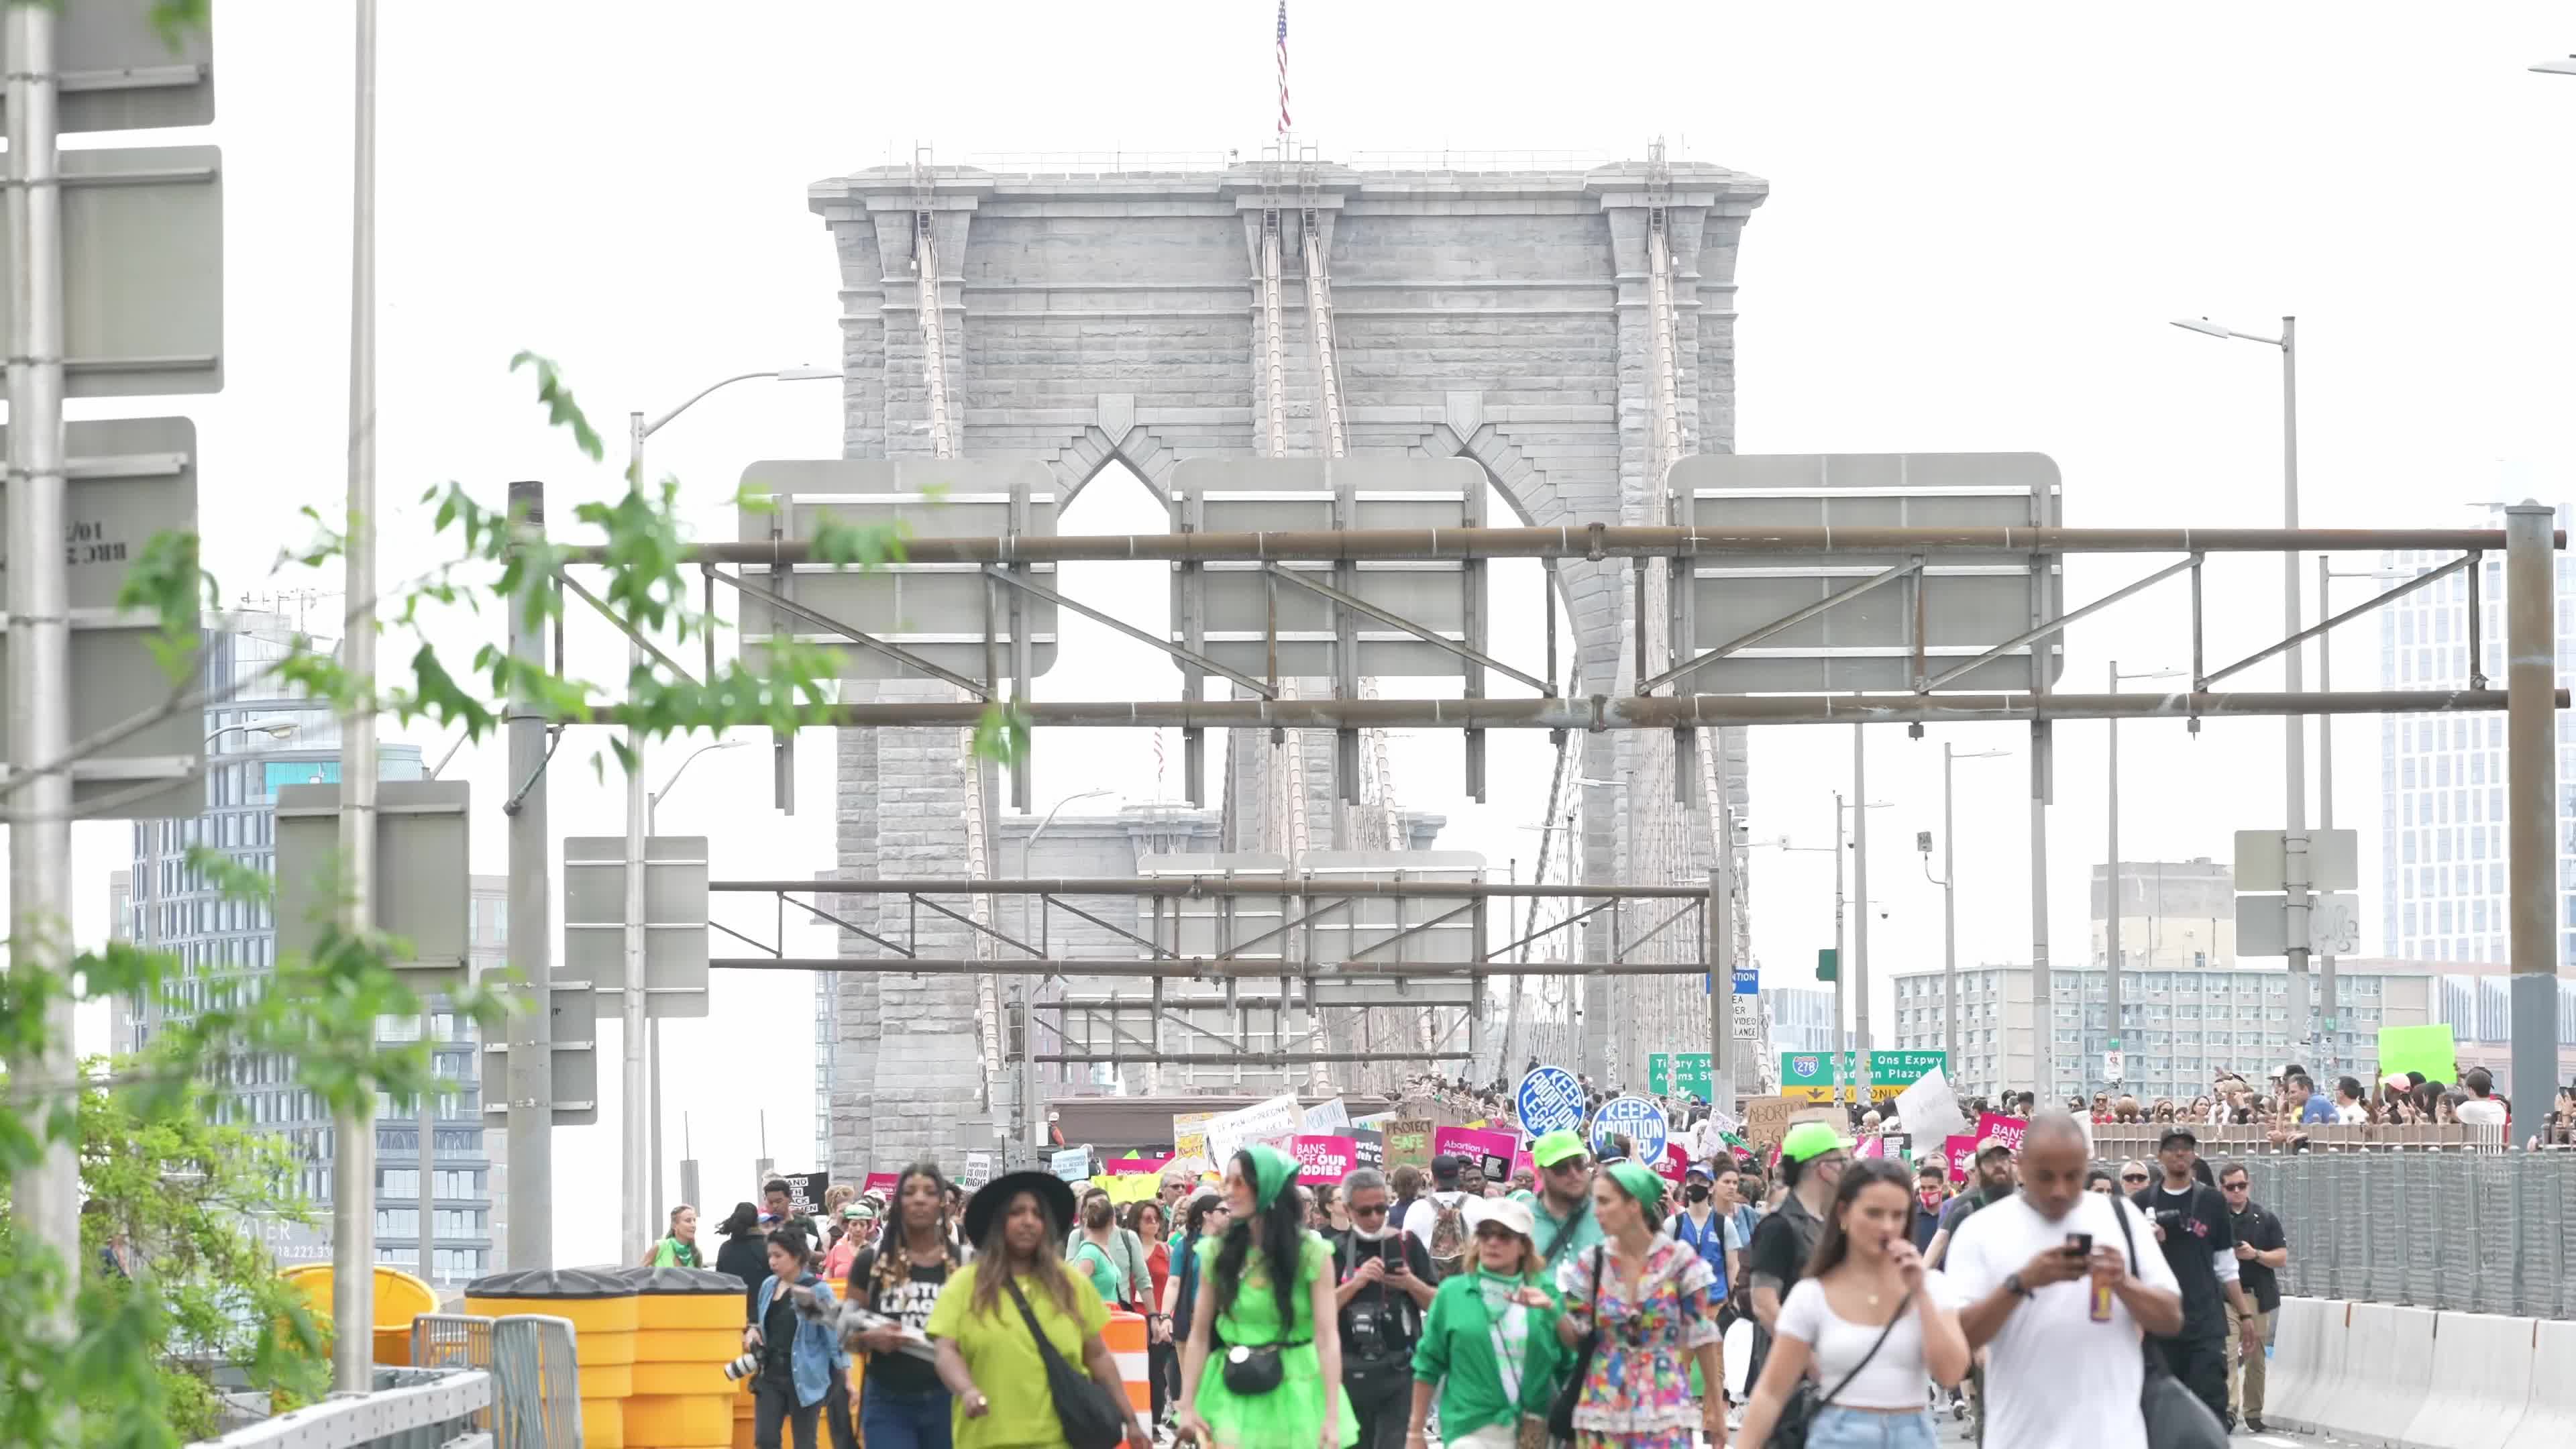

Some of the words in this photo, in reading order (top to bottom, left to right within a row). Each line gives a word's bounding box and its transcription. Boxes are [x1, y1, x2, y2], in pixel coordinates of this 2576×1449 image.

[1734, 1017, 1756, 1026] VIDEO
[1656, 1059, 1693, 1070] Tiary
[1699, 1059, 1711, 1067] St
[1905, 1055, 1943, 1066] Expwy
[1797, 1062, 1815, 1073] 278
[1656, 1073, 1693, 1081] Ams
[1700, 1072, 1712, 1081] St
[1888, 1069, 1922, 1079] Plaza
[1548, 1071, 1581, 1107] KEEP
[1527, 1072, 1579, 1132] ABORTION
[1606, 1099, 1650, 1120] KEEP
[1386, 1120, 1431, 1136] PROTECT
[1391, 1133, 1425, 1149] SAFE
[1443, 1139, 1481, 1152] Abortion
[1296, 1143, 1326, 1155] BANS
[1295, 1154, 1316, 1165] OFF
[1317, 1154, 1347, 1166] OUR
[975, 1169, 987, 1177] OUR
[1298, 1165, 1342, 1176] ODIES
